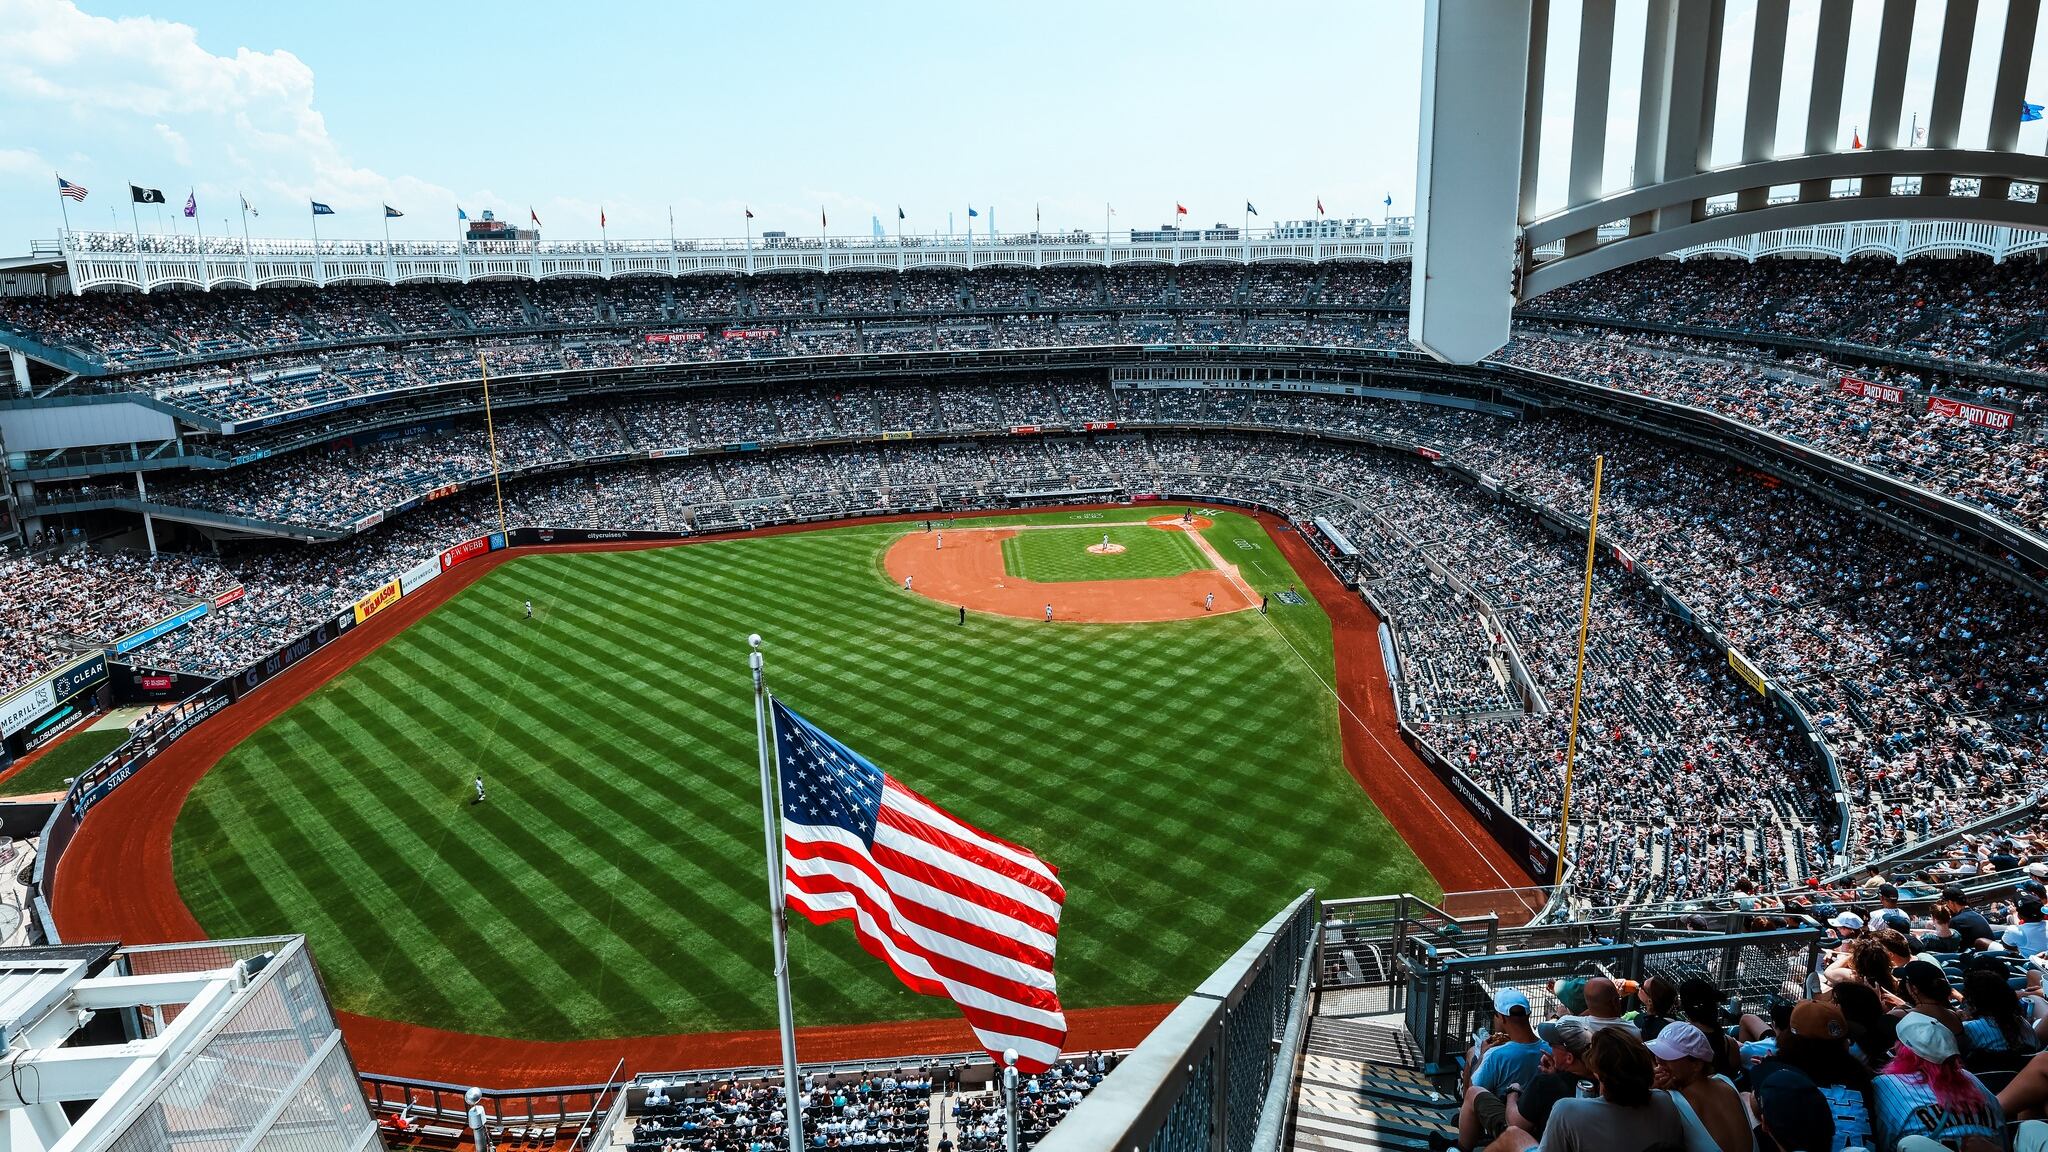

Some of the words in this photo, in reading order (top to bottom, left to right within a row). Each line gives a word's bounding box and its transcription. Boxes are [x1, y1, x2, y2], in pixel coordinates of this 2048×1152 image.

[1863, 384, 1882, 398] PARTY
[1883, 388, 1900, 402] DECK
[1960, 406, 1985, 423] PARTY
[1986, 412, 2010, 428] DECK
[404, 426, 427, 436] ULTRA
[587, 532, 622, 540] citycruises
[462, 539, 484, 553] WEBB
[73, 663, 103, 684] CLEAR
[209, 698, 230, 714] StubHub
[1, 702, 37, 728] MERRILL
[187, 711, 209, 727] StubHub
[169, 724, 188, 741] StubHub
[107, 767, 132, 792] STARR
[1452, 775, 1486, 814] citycruises
